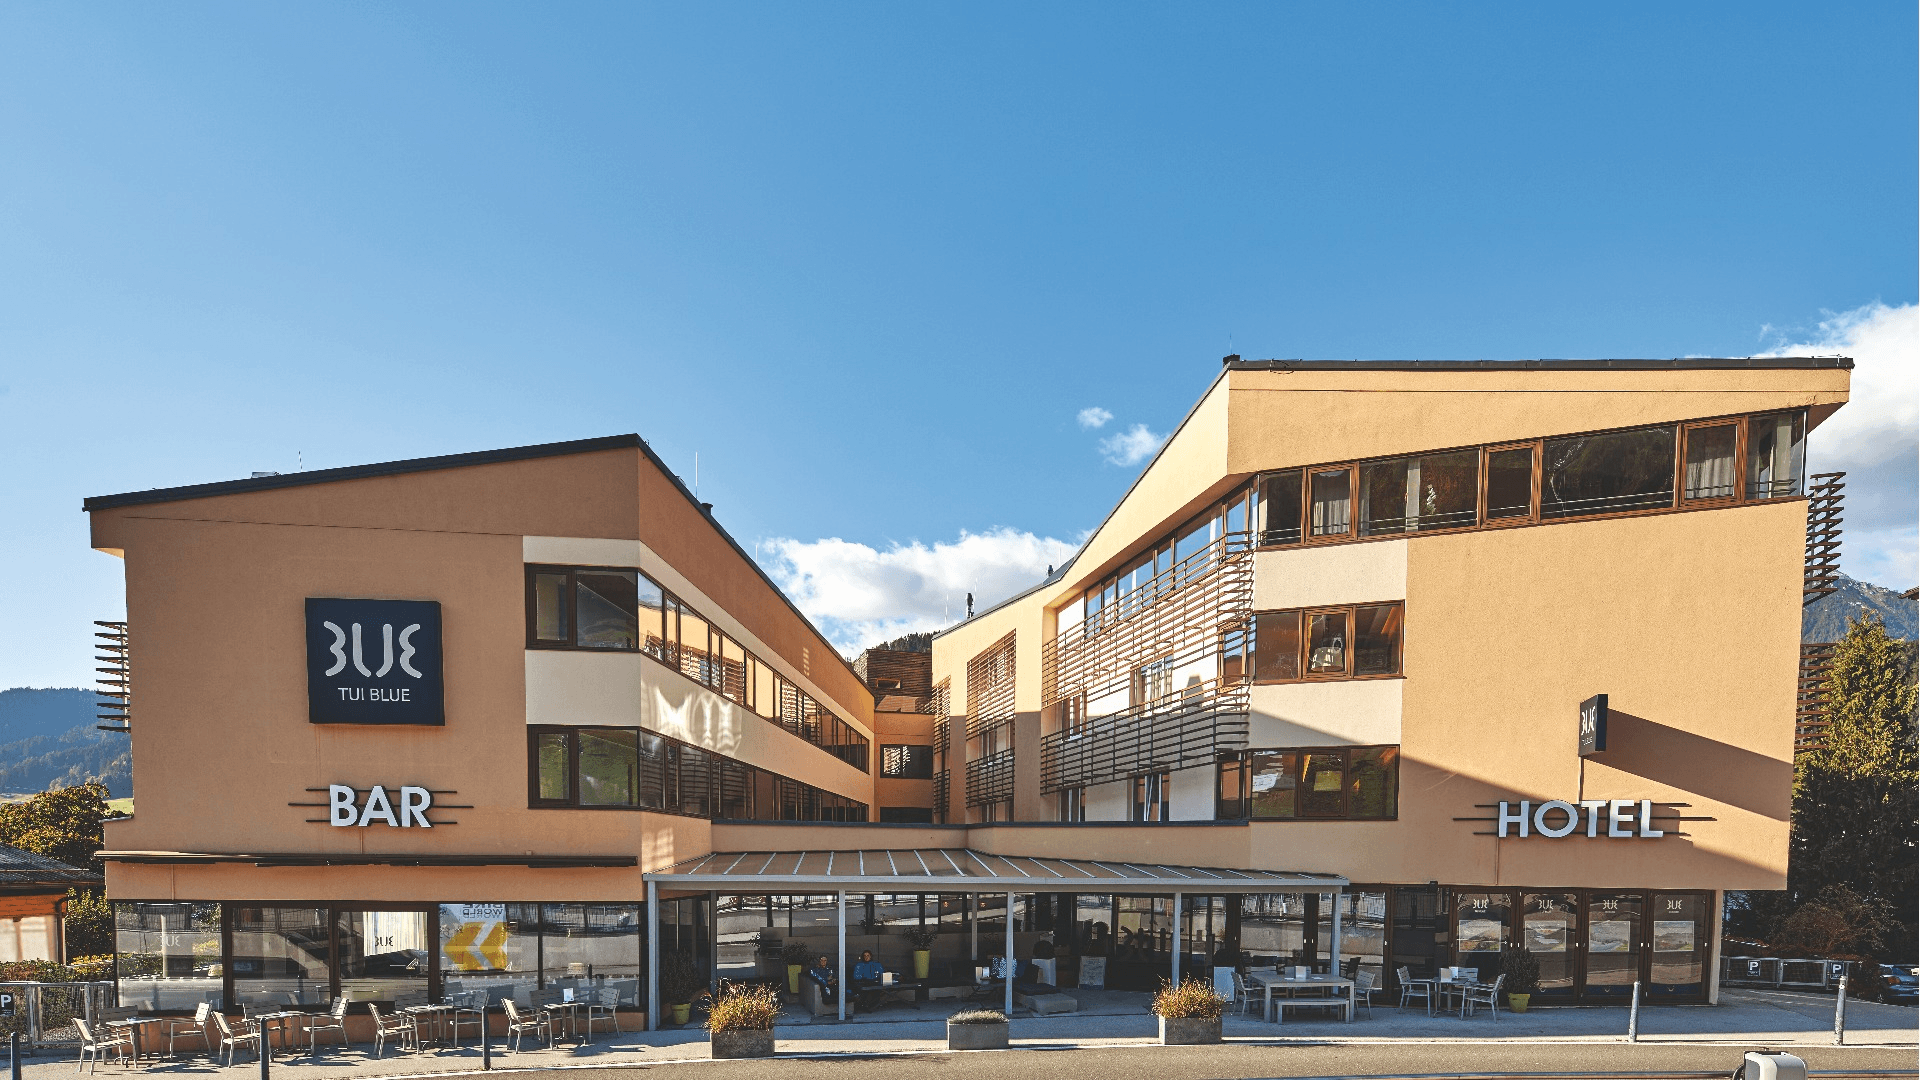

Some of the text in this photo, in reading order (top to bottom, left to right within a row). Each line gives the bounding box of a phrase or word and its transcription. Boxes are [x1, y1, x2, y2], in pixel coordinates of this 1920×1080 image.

[337, 687, 411, 702] TUI BLUE
[329, 784, 433, 828] BAR
[1498, 799, 1664, 838] HOTEL
[1749, 961, 1759, 971] P
[1832, 964, 1842, 974] P
[0, 994, 12, 1007] P
